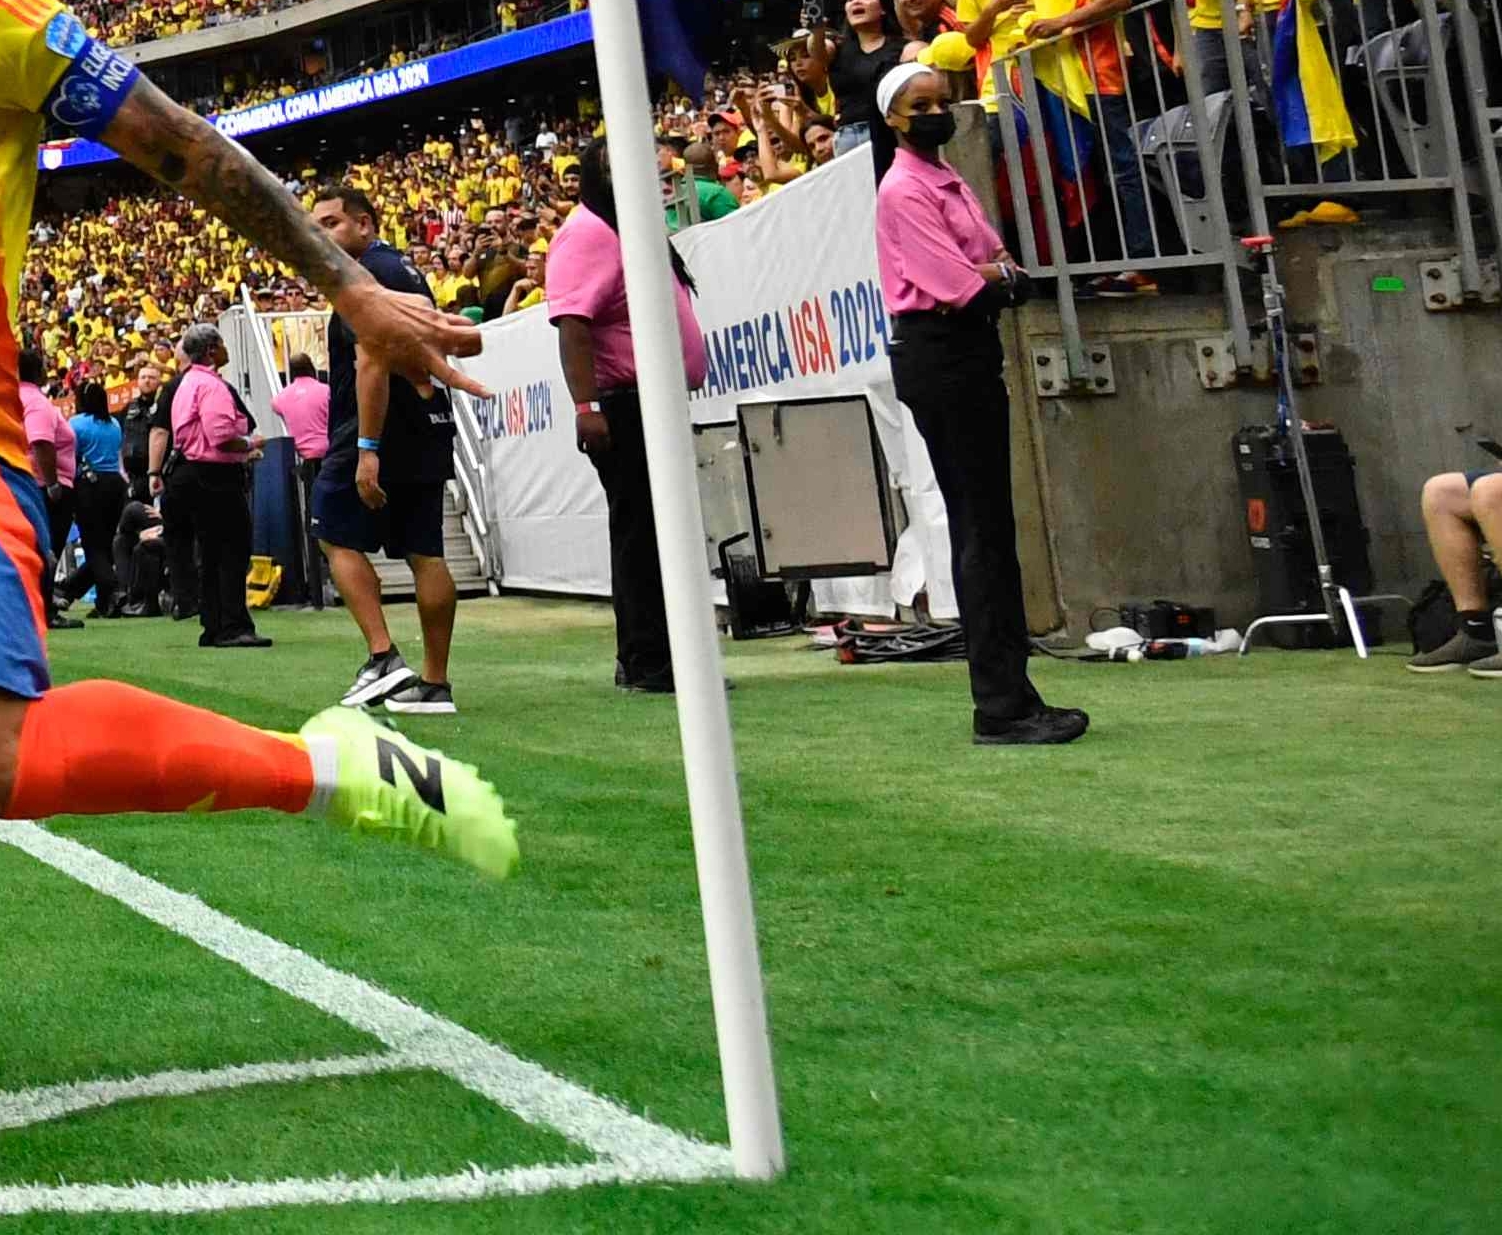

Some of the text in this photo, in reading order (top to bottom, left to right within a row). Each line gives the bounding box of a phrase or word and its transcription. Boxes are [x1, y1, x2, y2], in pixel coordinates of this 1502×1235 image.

[215, 62, 429, 137] CONMEBOL COPA AMERICA USA 2024
[703, 278, 892, 398] AMERICA USA 2024
[505, 386, 527, 438] USA
[526, 378, 553, 435] 2024
